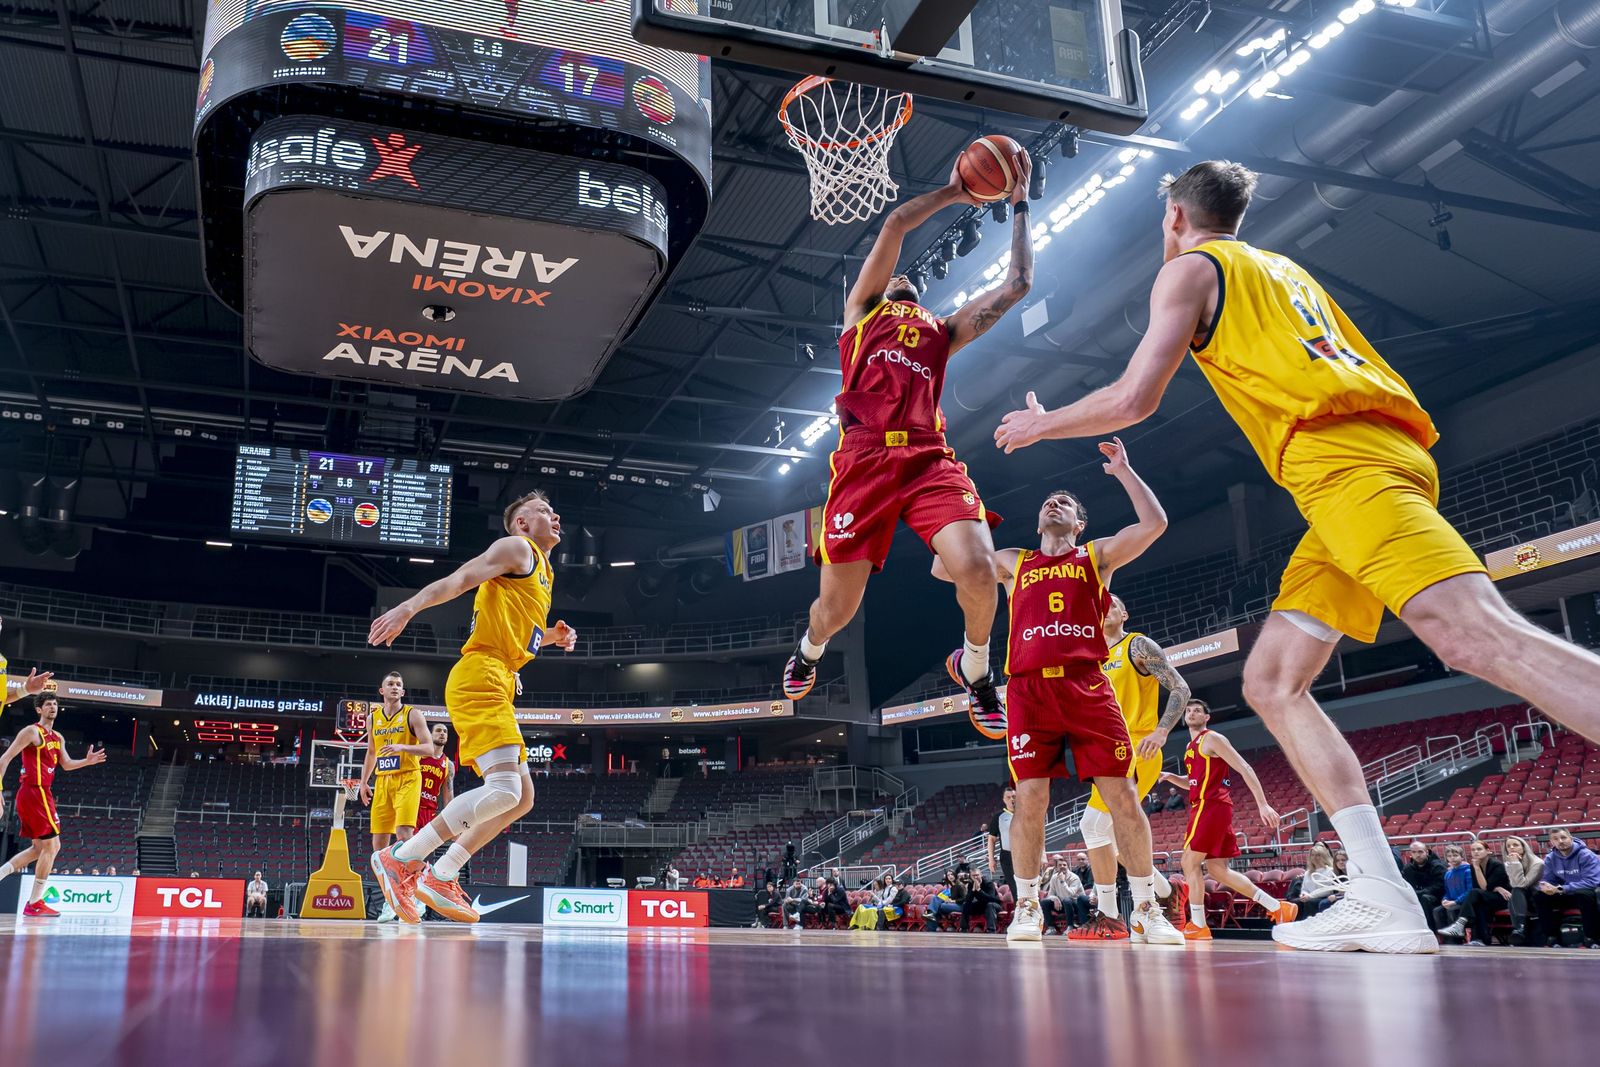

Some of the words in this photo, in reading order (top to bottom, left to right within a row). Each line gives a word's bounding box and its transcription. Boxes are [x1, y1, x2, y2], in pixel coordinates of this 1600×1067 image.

[368, 28, 409, 64] 21
[559, 62, 599, 96] 17
[337, 224, 580, 284] ARĒNA
[411, 273, 552, 306] XIAOMI
[336, 322, 466, 352] XIAOMI
[897, 324, 920, 348] 13
[322, 342, 520, 383] ARĒNA
[240, 445, 271, 456] UKRAINE
[319, 457, 334, 471] 21
[357, 461, 373, 474] 17
[430, 464, 450, 473] SPAIN
[312, 480, 318, 489] 5
[337, 477, 353, 488] 5.8
[751, 553, 765, 565] FIBA
[1021, 562, 1088, 590] ESPAÑA
[1048, 591, 1064, 613] 6
[1023, 620, 1095, 641] endesa
[68, 686, 146, 701] www.vairaksaules.lv
[194, 694, 232, 709] Atklāj
[233, 696, 275, 709] jaunas
[278, 699, 323, 712] garšas!
[593, 711, 661, 720] www.vairaksaules.lv
[693, 706, 761, 718] www.vairaksaules.lv
[374, 726, 404, 736] UKRAINE
[526, 744, 553, 757] safe
[379, 758, 398, 768] BGV
[424, 778, 434, 789] 10
[62, 889, 113, 904] Smart
[157, 887, 222, 908] TCL
[573, 900, 614, 915] Smart
[641, 899, 696, 919] TCL
